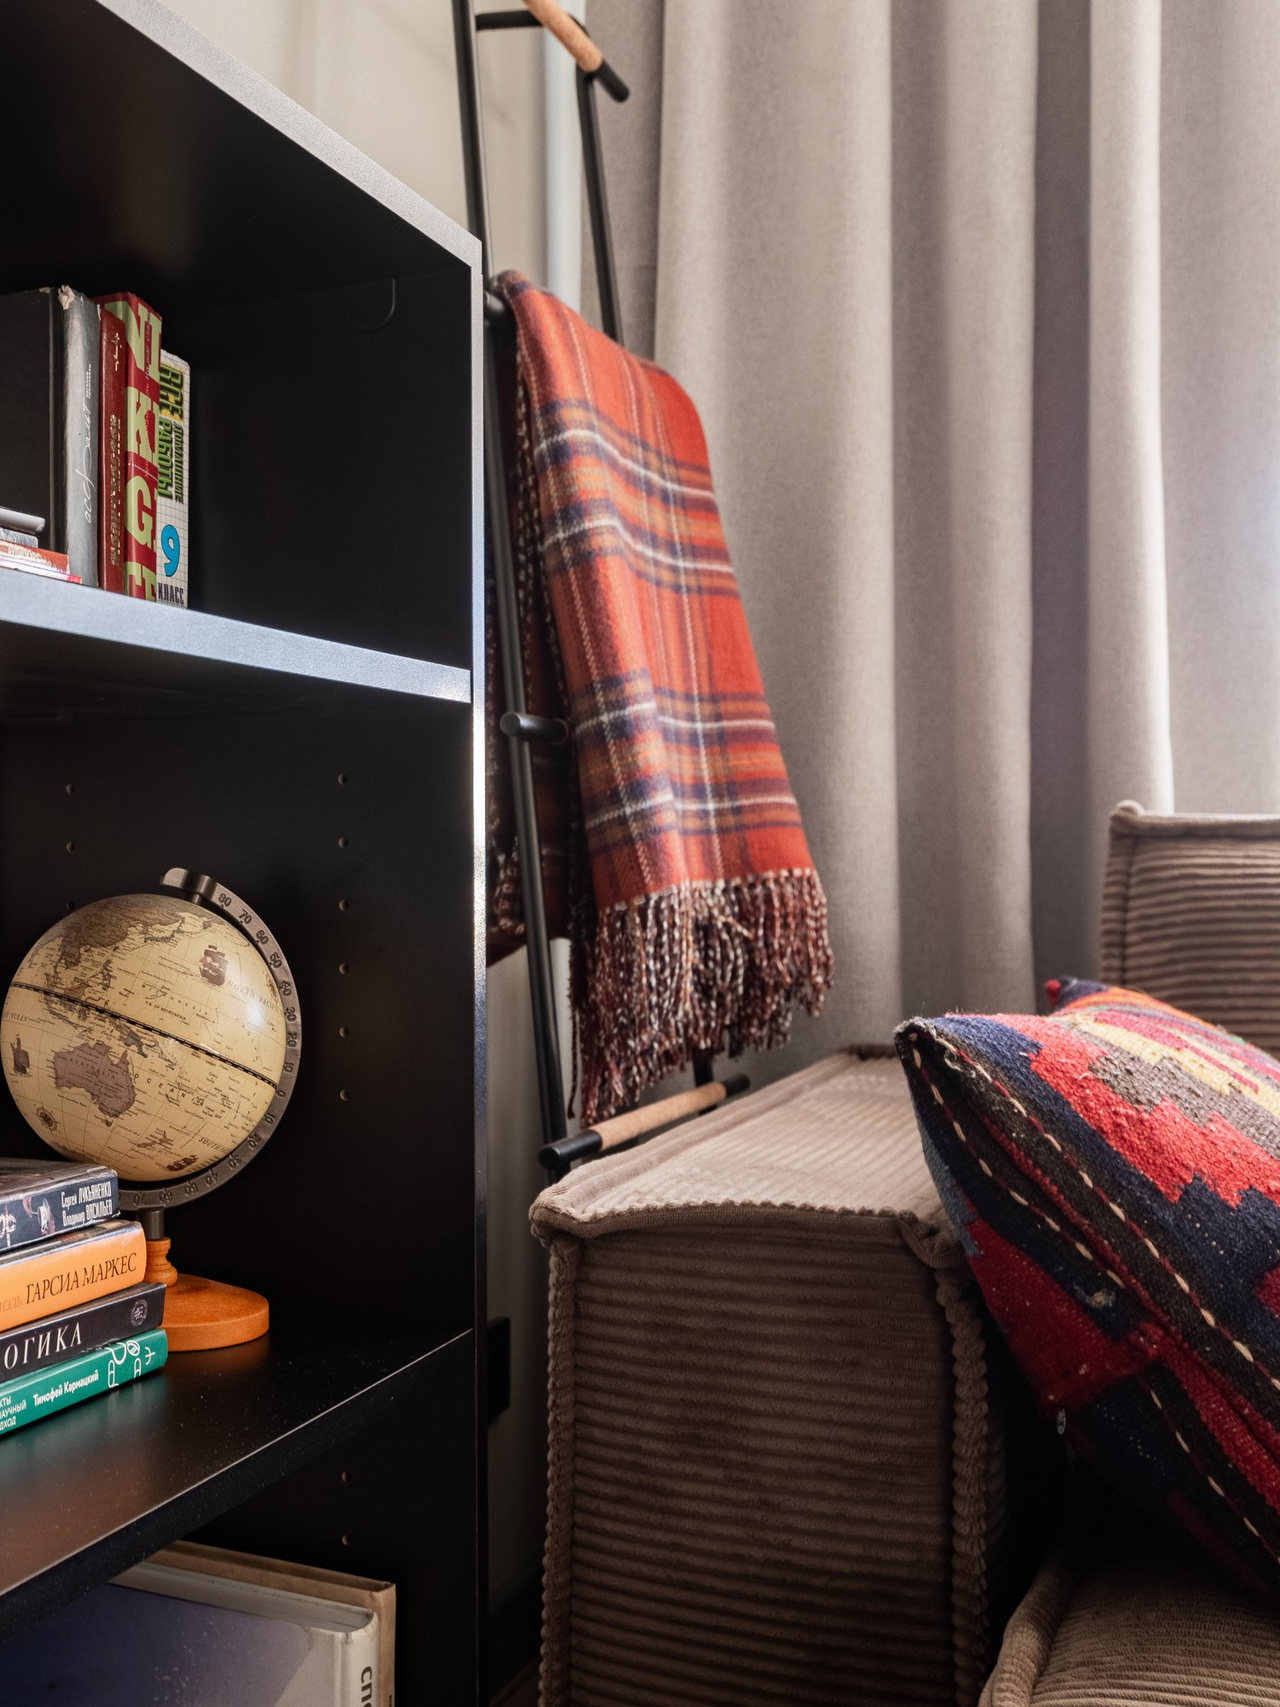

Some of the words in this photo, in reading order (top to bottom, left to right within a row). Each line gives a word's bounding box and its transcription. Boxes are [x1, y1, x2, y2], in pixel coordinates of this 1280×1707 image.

[159, 365, 184, 419] ВСЕ
[158, 418, 174, 500] РАБОТЫ
[173, 420, 184, 505] ДОМАШНИЕ
[161, 524, 181, 578] 9
[157, 582, 185, 605] КЛАСС
[239, 909, 253, 925] 70
[255, 930, 270, 945] 60
[270, 952, 283, 969] 50
[281, 980, 292, 997] 40
[286, 1006, 297, 1023] 30
[61, 1191, 78, 1208] Сергей
[85, 1198, 114, 1223] ВАСИЛЬЕВ
[25, 1267, 81, 1306] ГАРСИА
[81, 1251, 138, 1288] МАРКЕС
[33, 1386, 64, 1408] Тимофей
[63, 1369, 100, 1398] Кармацкий
